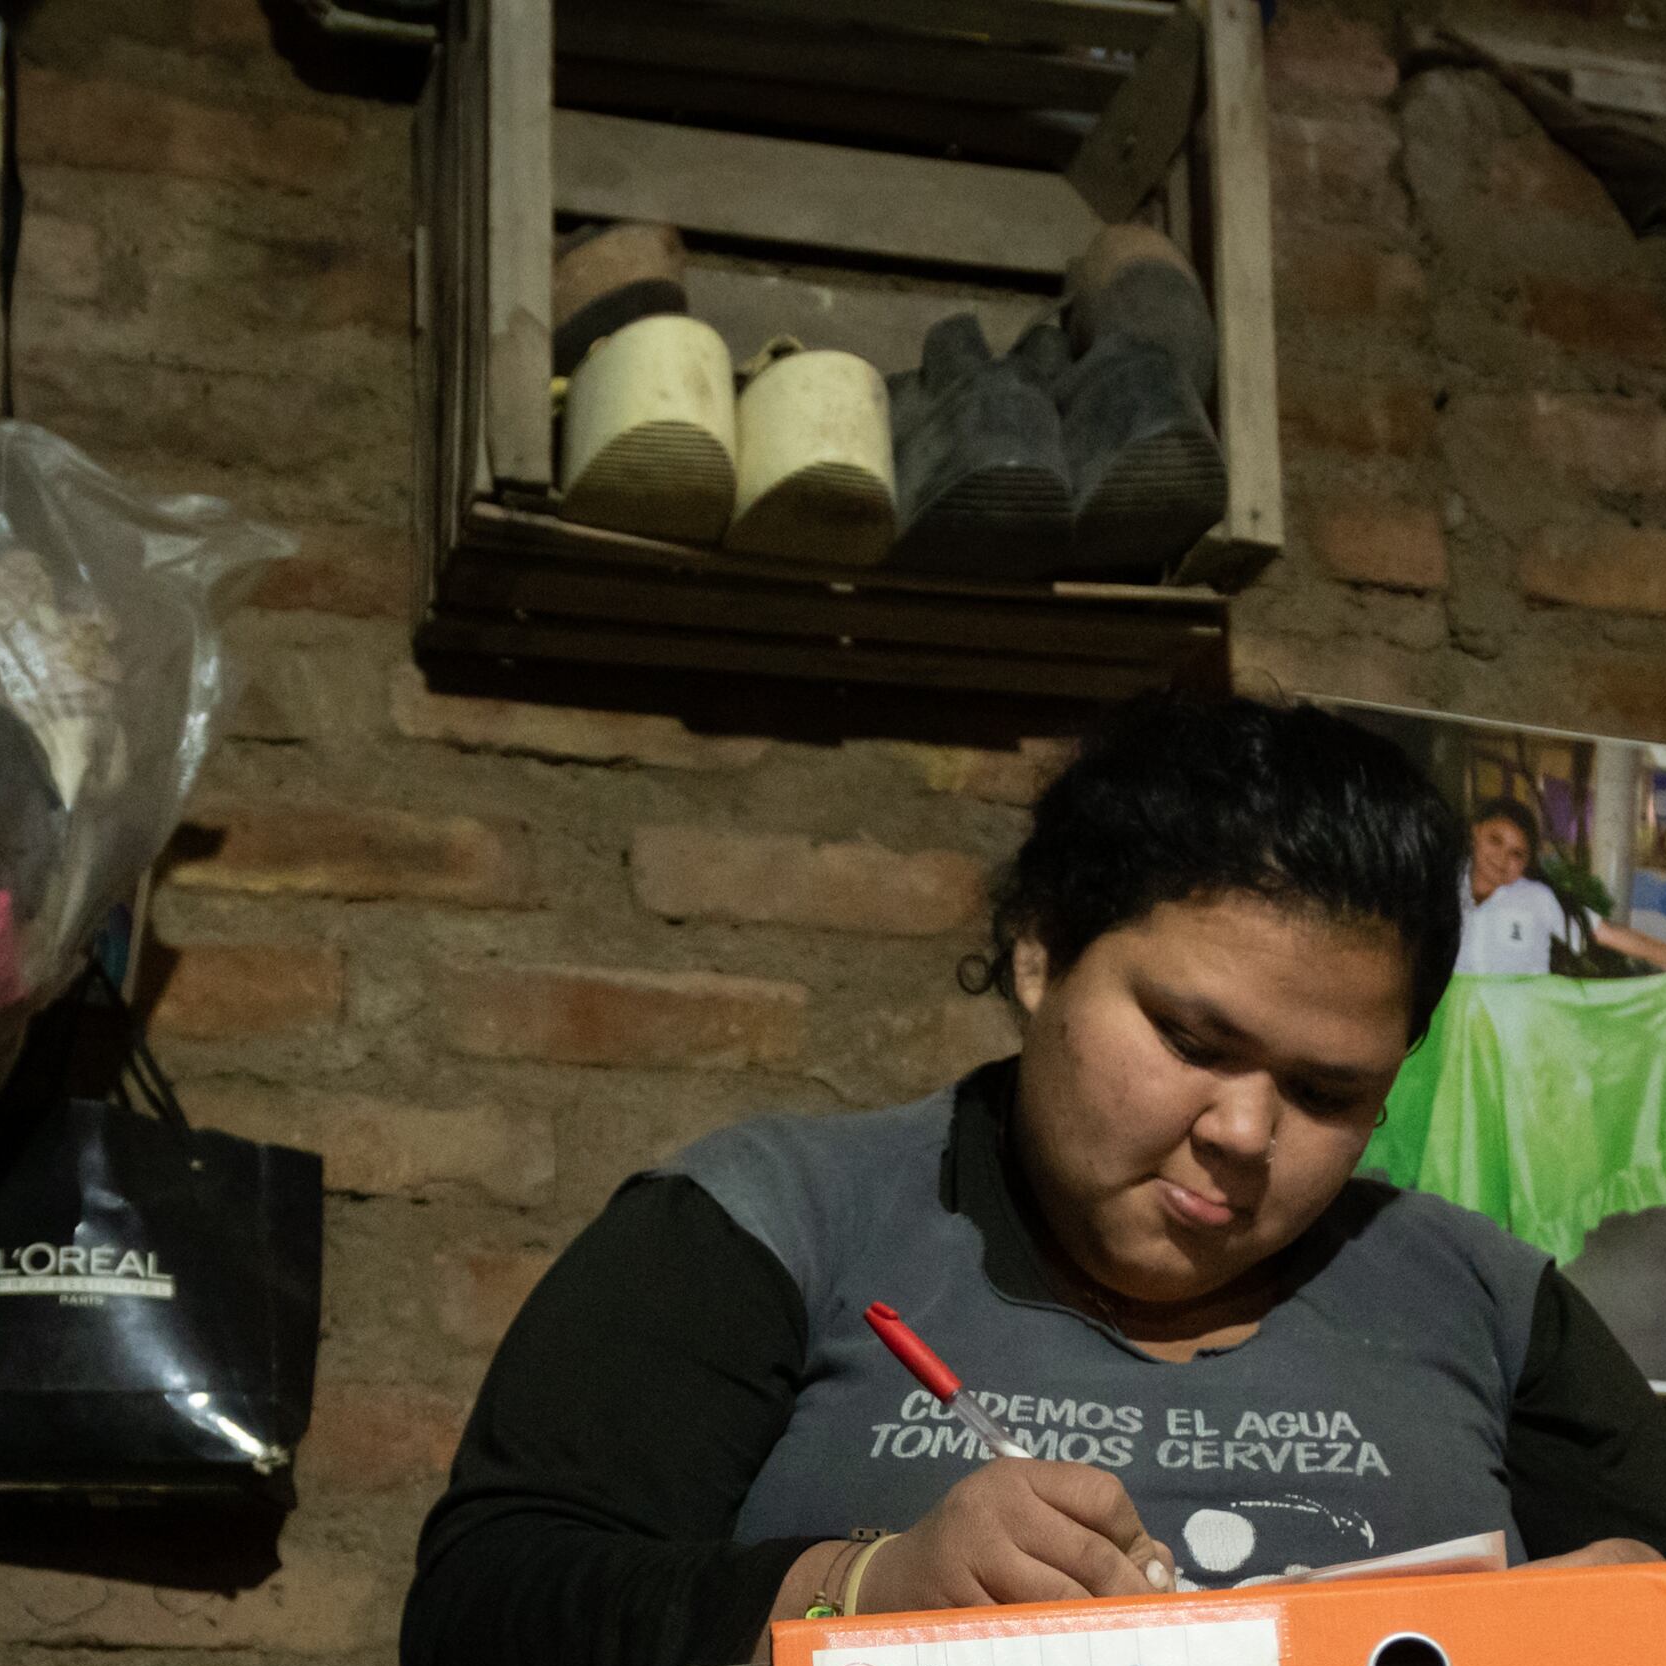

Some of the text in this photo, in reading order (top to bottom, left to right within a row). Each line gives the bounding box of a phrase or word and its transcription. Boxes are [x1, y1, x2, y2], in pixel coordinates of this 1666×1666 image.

[59, 1296, 104, 1308] PARIS
[1167, 1408, 1220, 1438] EL
[1235, 1410, 1361, 1440] AGUA
[1157, 1440, 1391, 1477] CERVEZA
